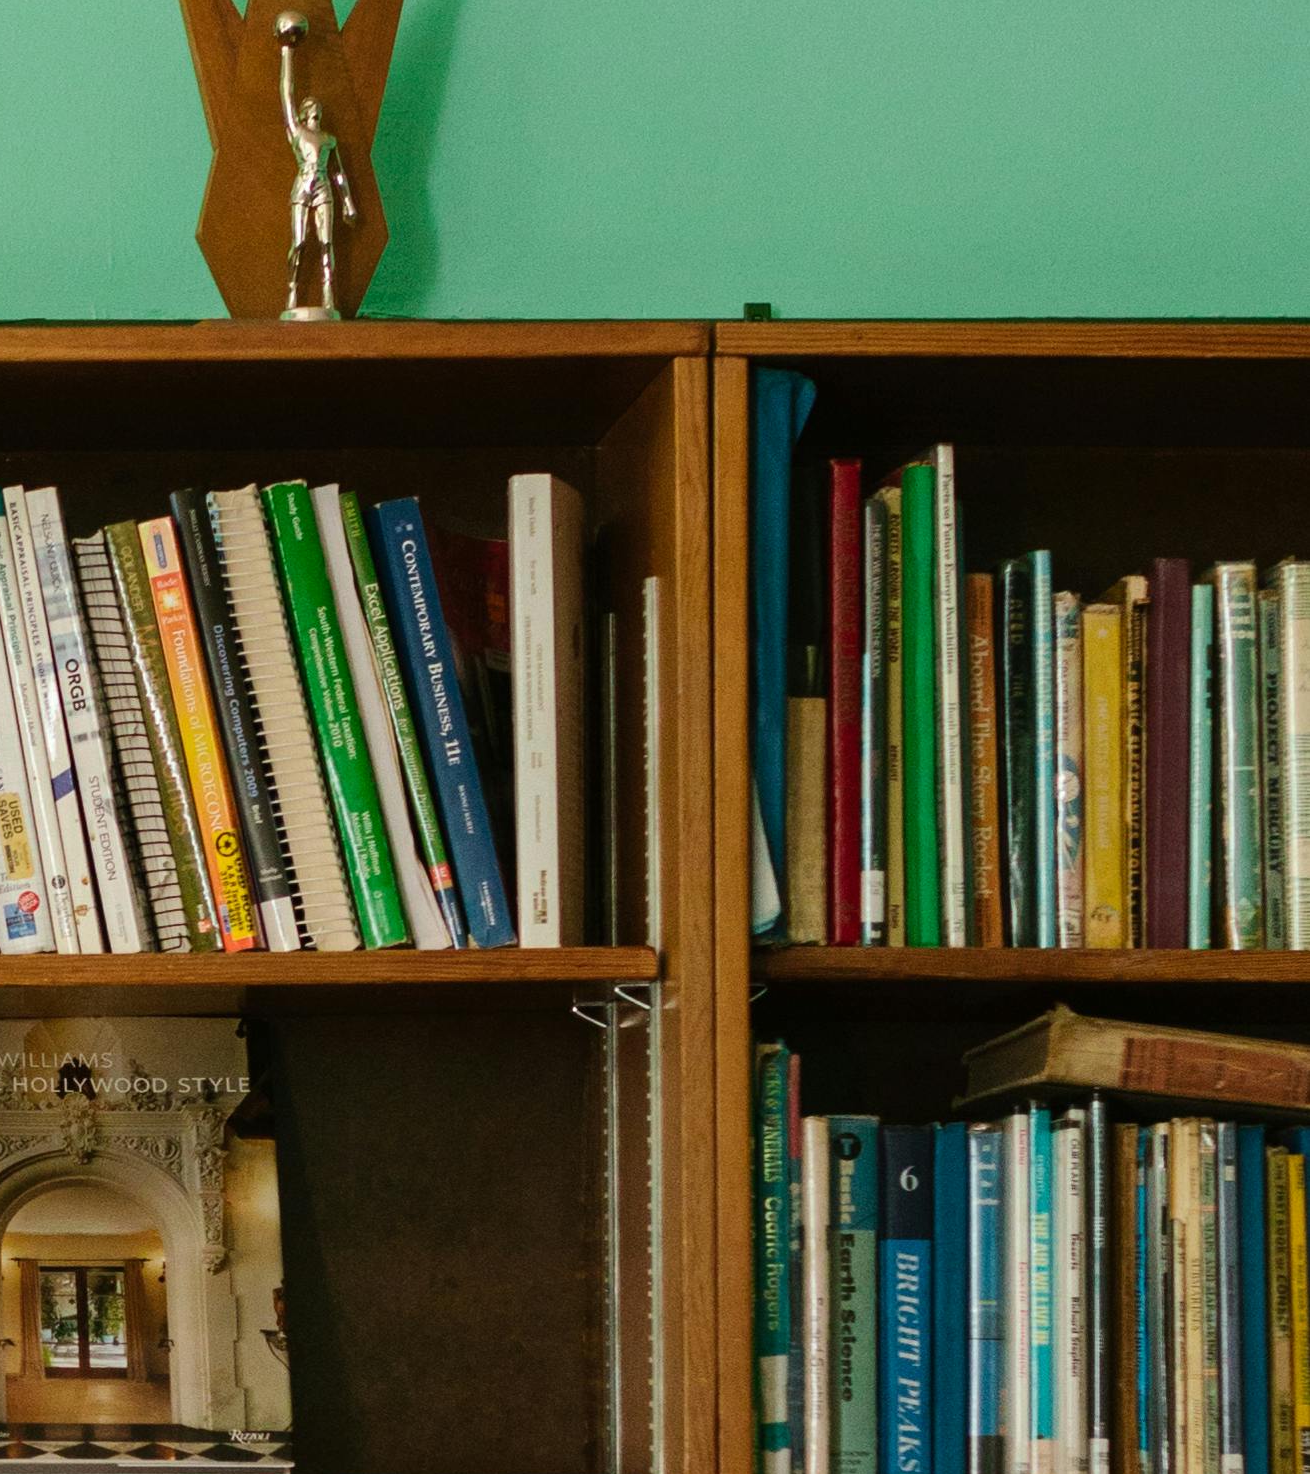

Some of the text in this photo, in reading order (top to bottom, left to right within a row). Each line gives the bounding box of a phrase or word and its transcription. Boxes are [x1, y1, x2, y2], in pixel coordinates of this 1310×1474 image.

[63, 657, 88, 713] ORGB
[211, 623, 261, 800] Discovering Computers 2009
[399, 538, 463, 767] CONTEMPORARY BUSINESS, 11E
[12, 1076, 169, 1094] HOLLYWOOD
[178, 1077, 251, 1094] STYLE
[898, 1164, 919, 1193] 6
[838, 1232, 855, 1403] Earth Science
[896, 1251, 923, 1474] BRIGHT PEAKS
